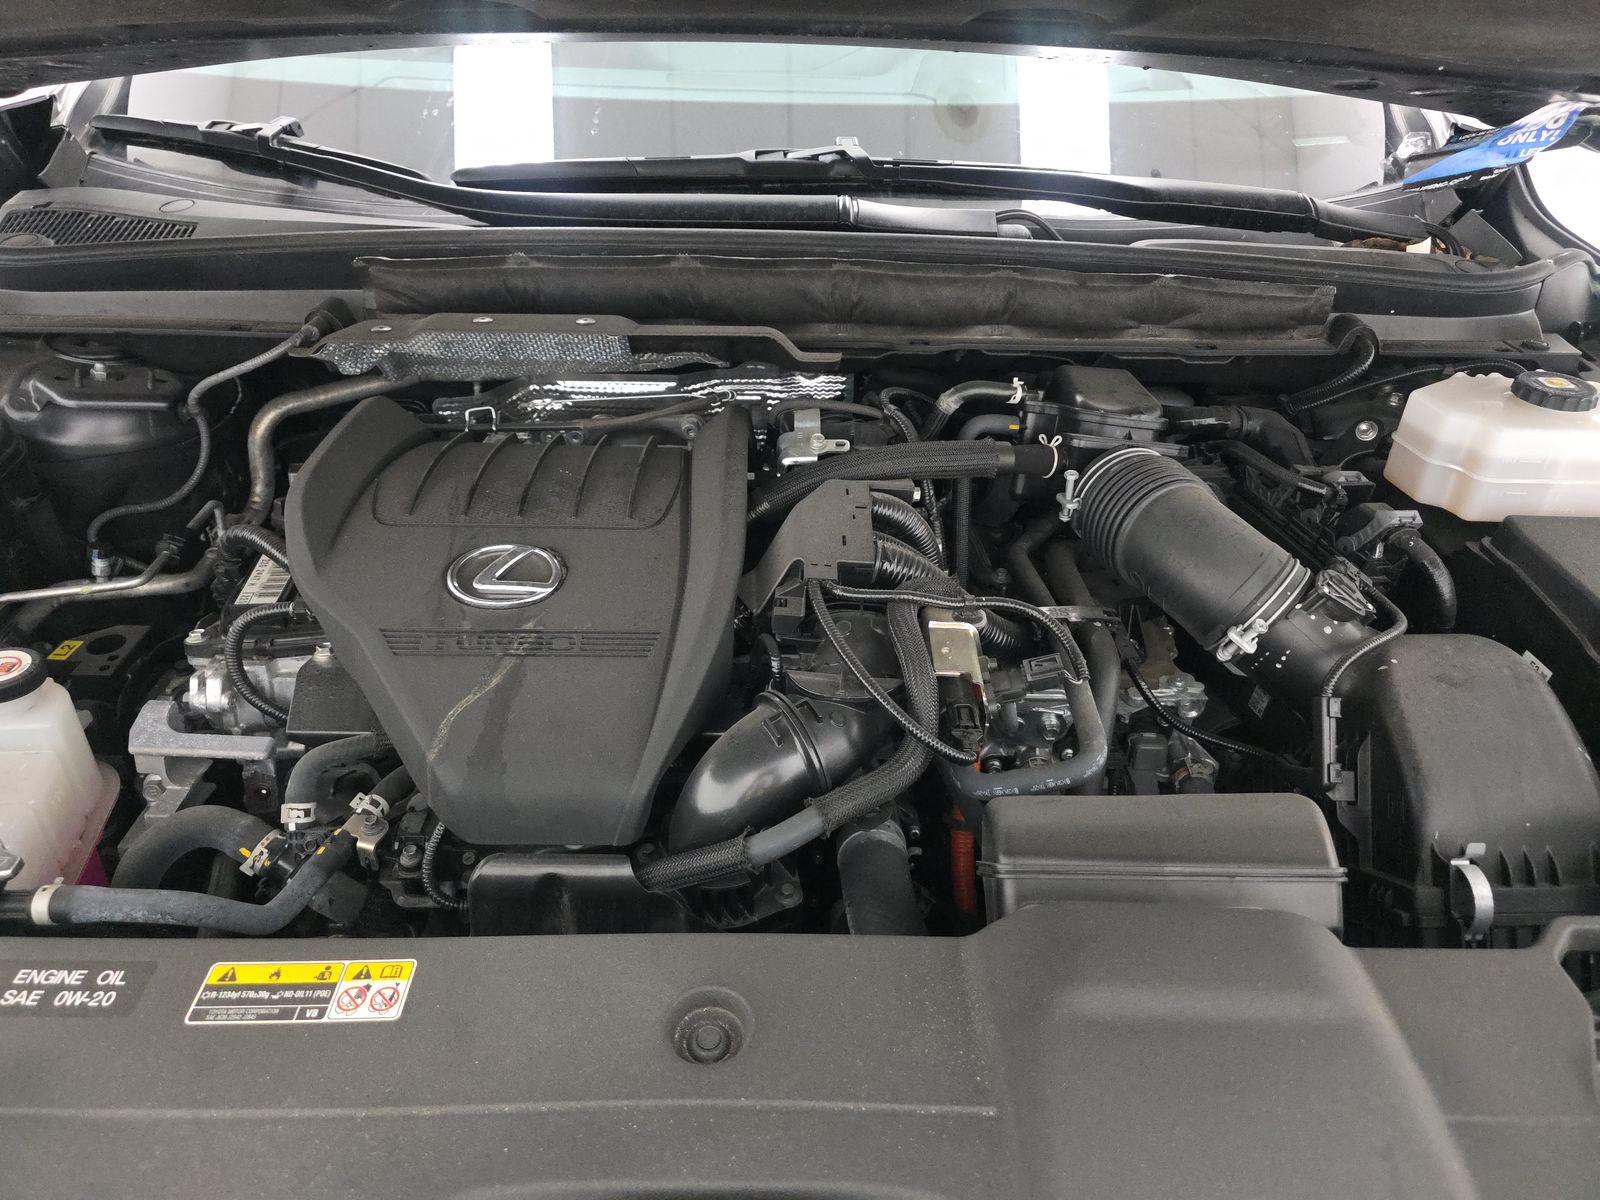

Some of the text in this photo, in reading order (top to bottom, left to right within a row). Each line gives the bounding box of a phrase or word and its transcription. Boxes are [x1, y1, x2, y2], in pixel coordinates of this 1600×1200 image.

[12, 969, 126, 986] ENGINE OIL
[0, 989, 117, 1007] SAE 0W-20
